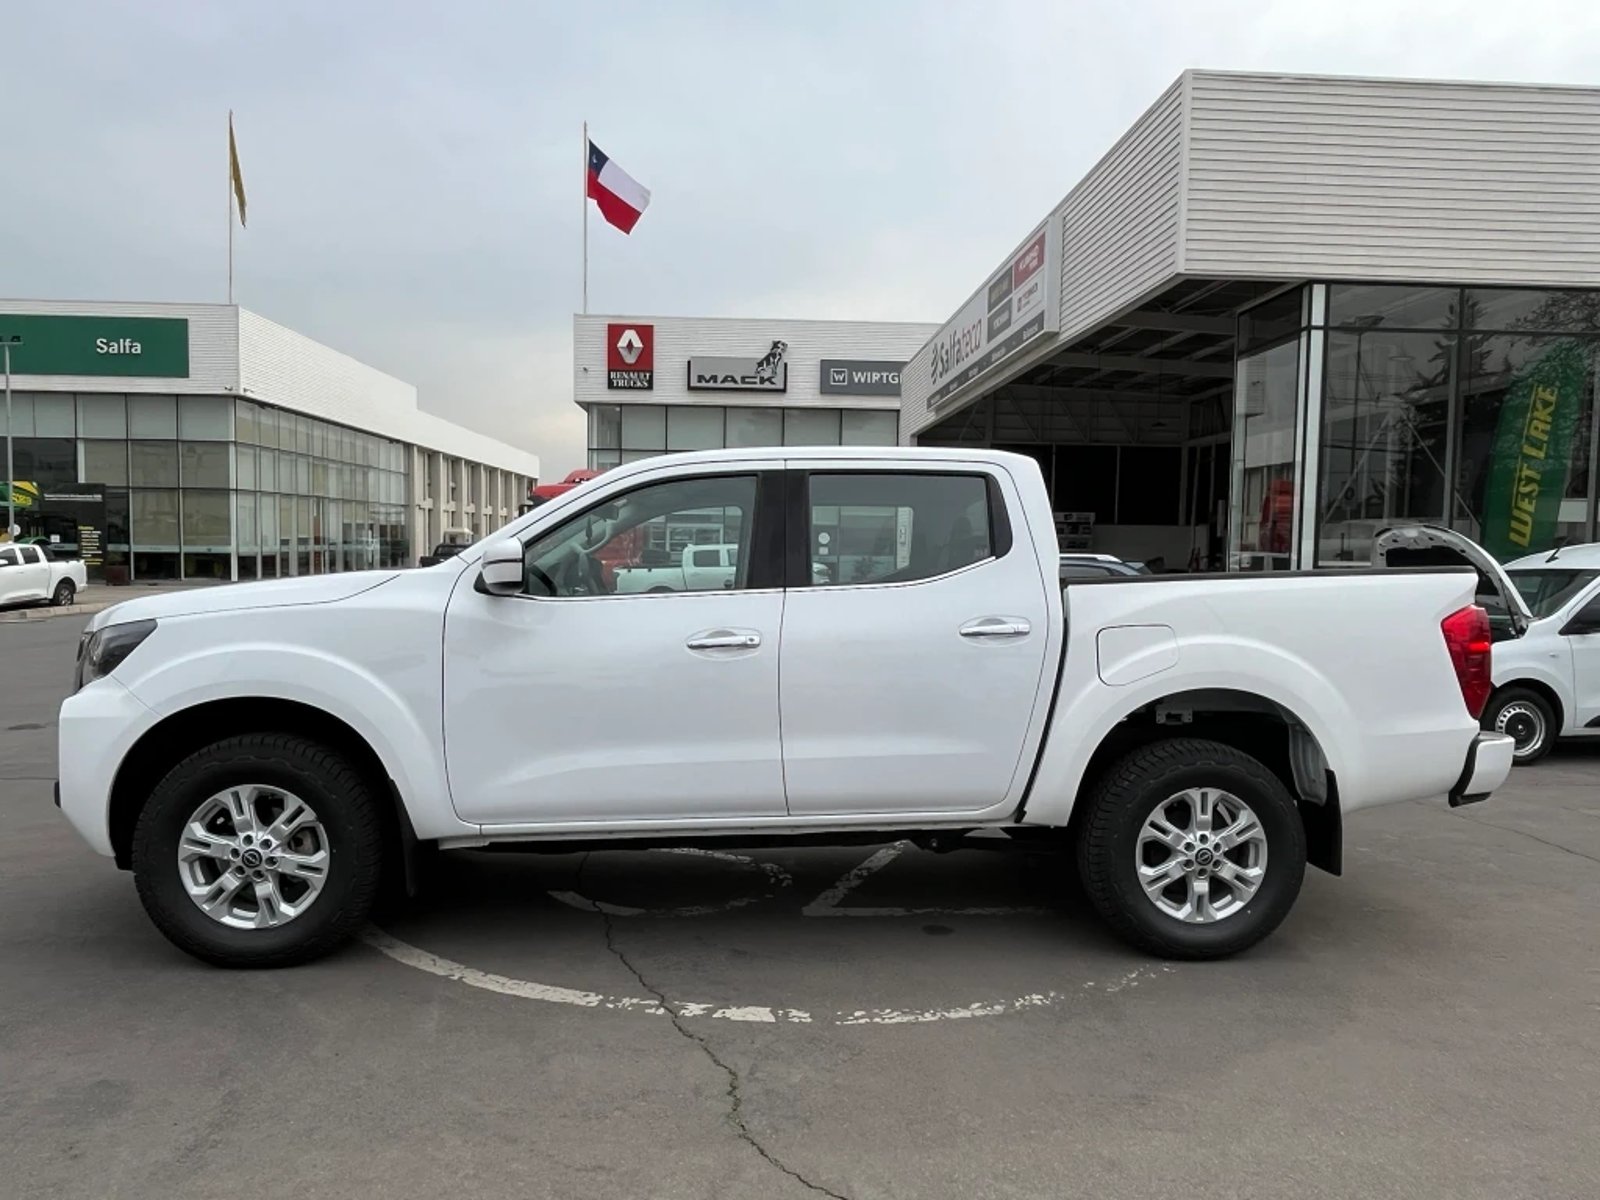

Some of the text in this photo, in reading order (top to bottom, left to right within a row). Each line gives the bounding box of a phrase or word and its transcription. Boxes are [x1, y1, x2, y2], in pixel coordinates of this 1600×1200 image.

[96, 338, 142, 354] Salfa
[697, 374, 776, 385] MACK
[852, 371, 902, 384] WIRTG
[1508, 384, 1559, 547] WEST LAKE
